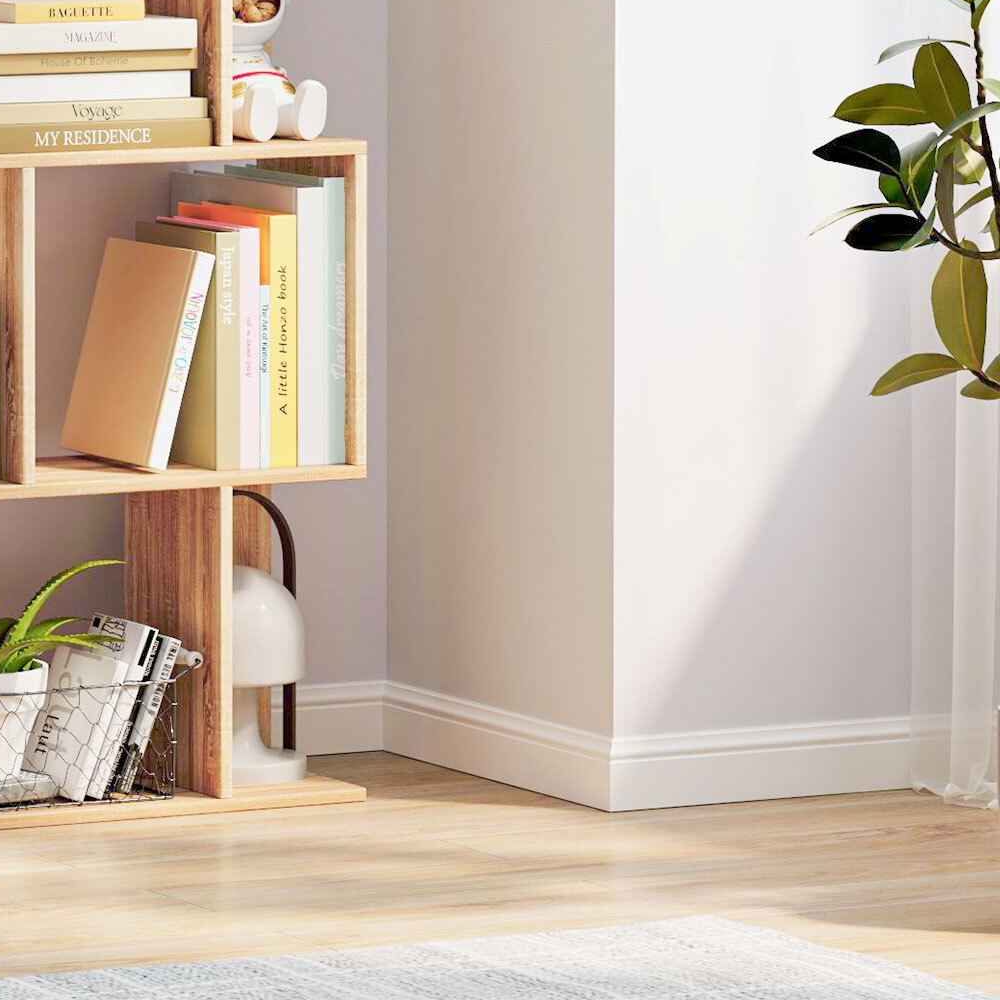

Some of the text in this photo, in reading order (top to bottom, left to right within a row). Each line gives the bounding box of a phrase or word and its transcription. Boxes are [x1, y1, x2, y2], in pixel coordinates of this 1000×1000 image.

[48, 6, 114, 18] BAGUETTE
[63, 31, 118, 44] MAGAZINE
[40, 57, 71, 67] House
[74, 56, 87, 67] Of
[72, 103, 123, 121] Voyage
[34, 127, 152, 147] MY RESIDENCE
[219, 246, 236, 325] Japan style
[261, 304, 269, 318] The
[261, 319, 269, 331] Art
[277, 264, 288, 415] A little Honzo book
[166, 641, 180, 660] FINAL
